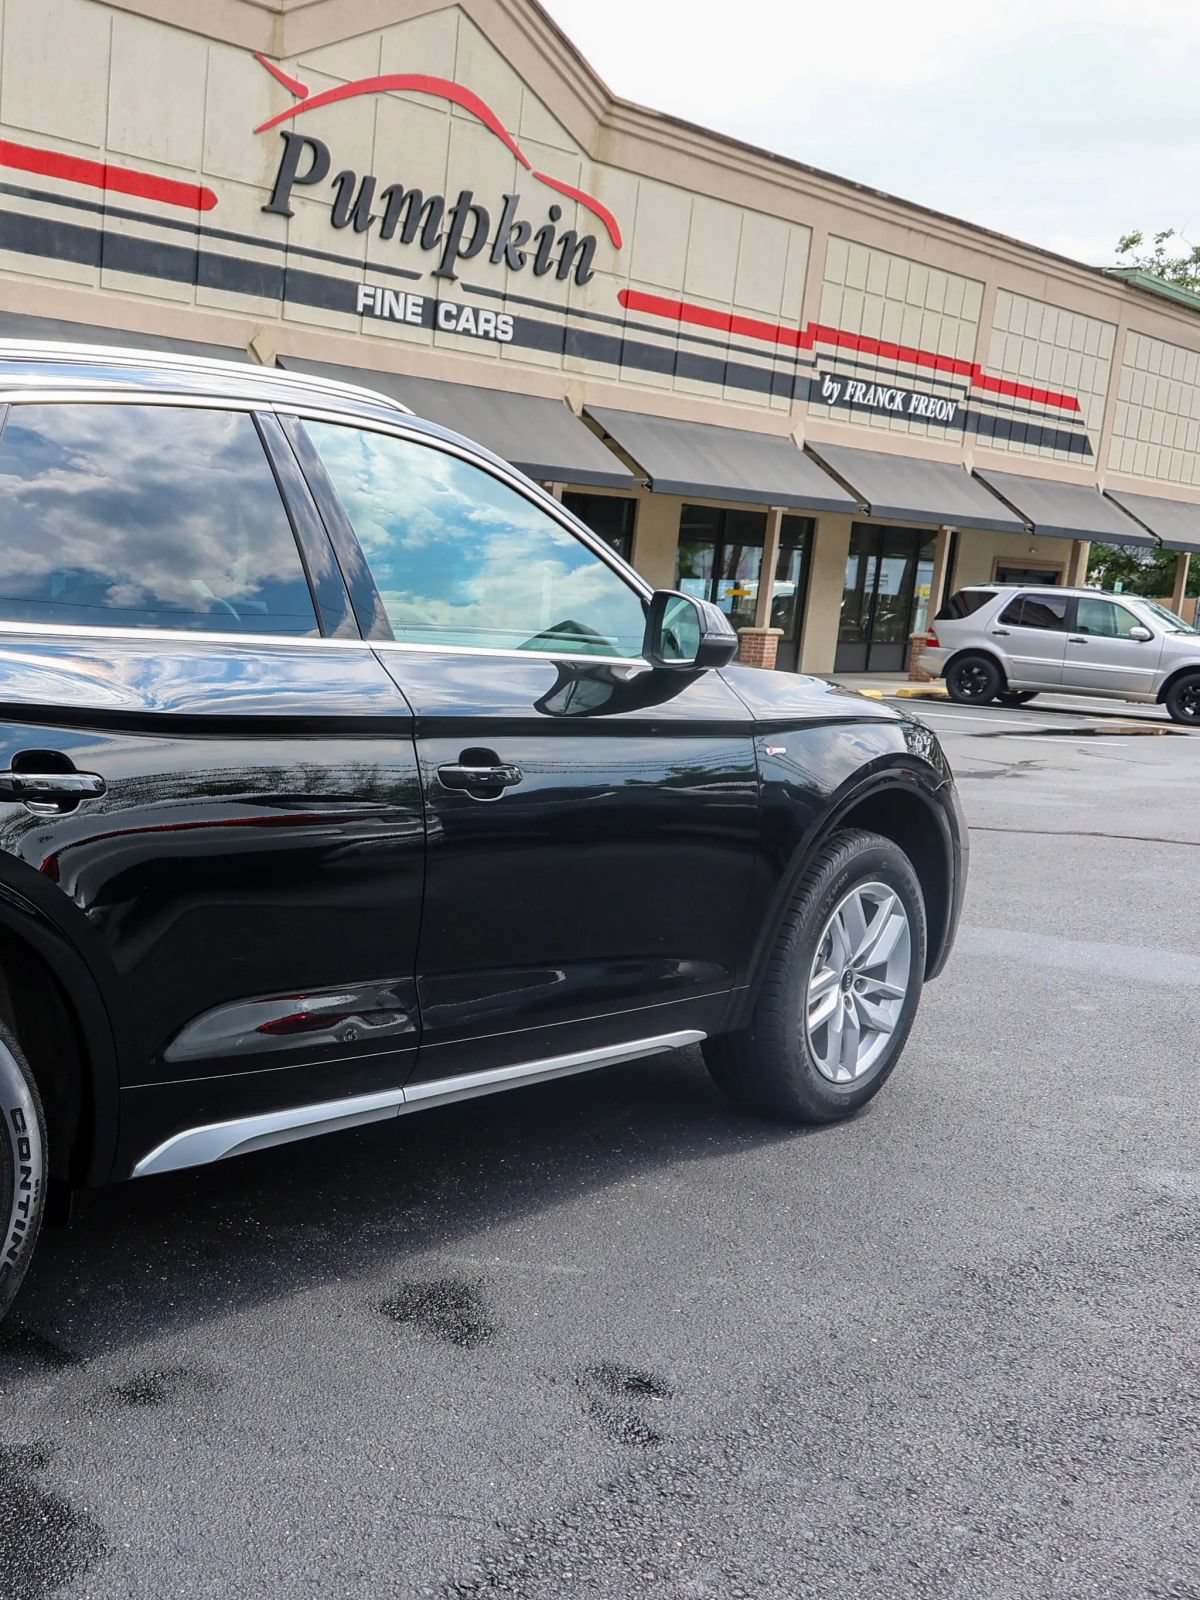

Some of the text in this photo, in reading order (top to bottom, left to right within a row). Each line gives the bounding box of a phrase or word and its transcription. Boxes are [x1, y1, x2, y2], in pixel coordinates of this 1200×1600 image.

[261, 130, 598, 287] Pumpkin
[356, 284, 515, 342] FINE CARS
[821, 375, 957, 422] by FRANCK FREON
